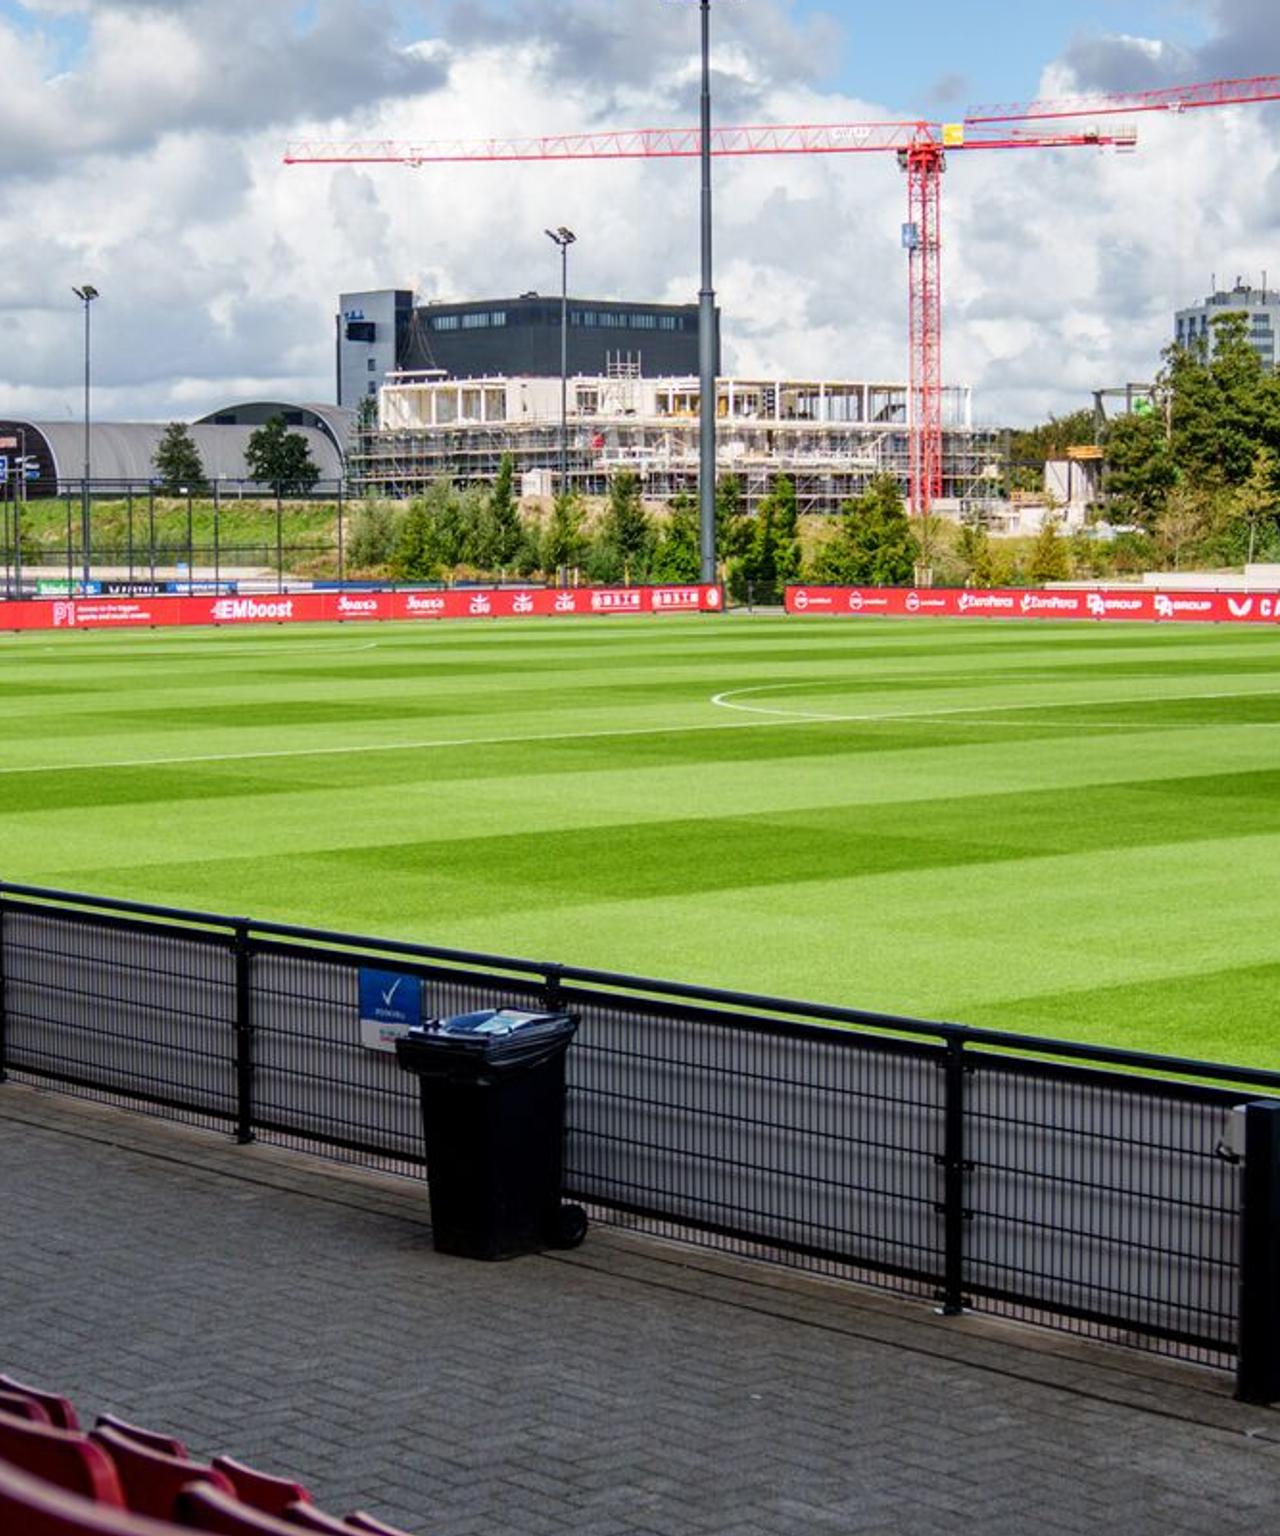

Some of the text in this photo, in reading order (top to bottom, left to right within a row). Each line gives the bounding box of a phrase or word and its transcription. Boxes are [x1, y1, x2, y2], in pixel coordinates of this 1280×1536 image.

[470, 601, 490, 614] CSU
[513, 600, 533, 612] CSU
[555, 599, 575, 611] CSU
